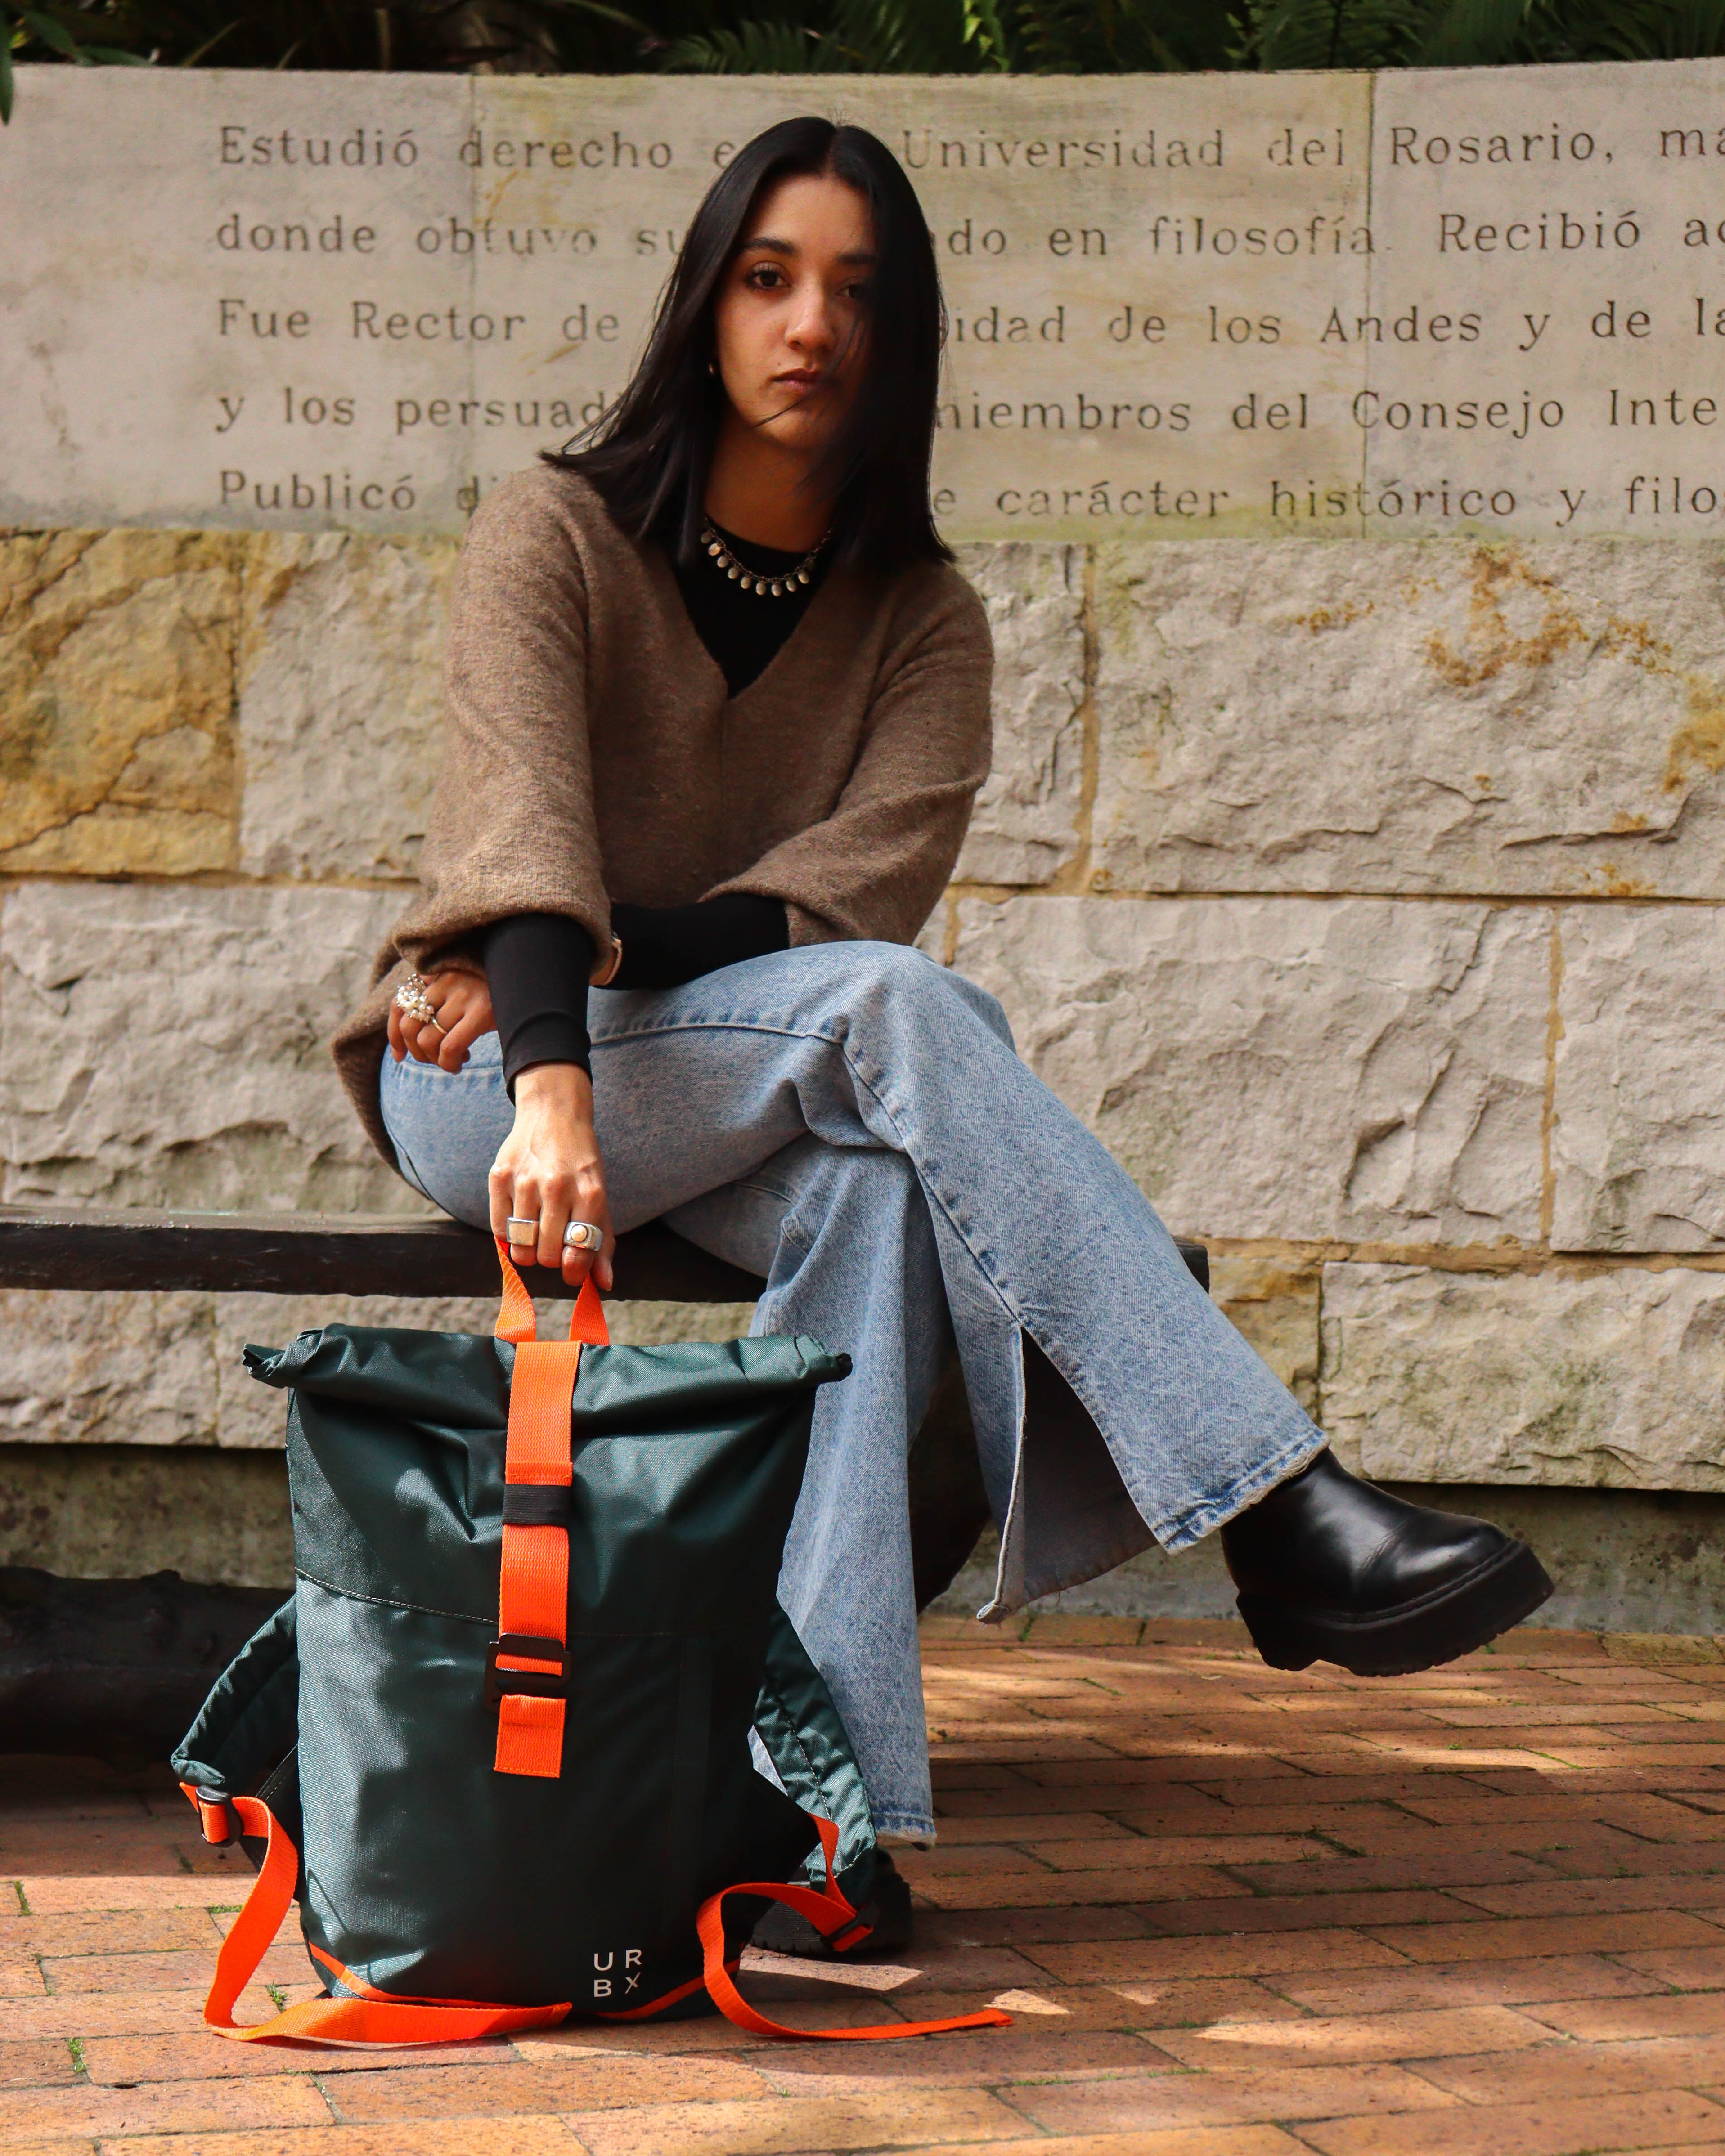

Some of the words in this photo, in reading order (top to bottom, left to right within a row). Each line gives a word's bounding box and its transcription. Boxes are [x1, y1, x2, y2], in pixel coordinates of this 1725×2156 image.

[220, 126, 418, 166] Estudió
[458, 130, 672, 168] derecho
[903, 129, 1223, 168] Universidad
[1268, 128, 1343, 166] del
[1391, 122, 1613, 165] Rosario,
[217, 213, 375, 253] donde
[417, 217, 597, 255] obtuvo
[1048, 228, 1108, 256] en
[1440, 210, 1640, 252] Recibió
[219, 299, 310, 338] Fue
[352, 301, 526, 341] Rector
[562, 304, 619, 342] de
[956, 305, 1065, 343] idad
[1109, 305, 1166, 343] de
[1209, 305, 1281, 344] los
[1320, 305, 1482, 343] Andes
[1519, 314, 1551, 351] y
[1591, 300, 1651, 337] de
[215, 396, 245, 432] y
[284, 387, 355, 426] los
[396, 390, 622, 435] persuad
[1232, 393, 1308, 430] del
[1352, 390, 1564, 439] Consejo
[1609, 389, 1717, 426] Inte
[220, 470, 416, 511] Publicó
[997, 480, 1231, 518] carácter
[1271, 479, 1515, 517] histórico
[1555, 489, 1586, 527] y
[1625, 476, 1725, 514] filo
